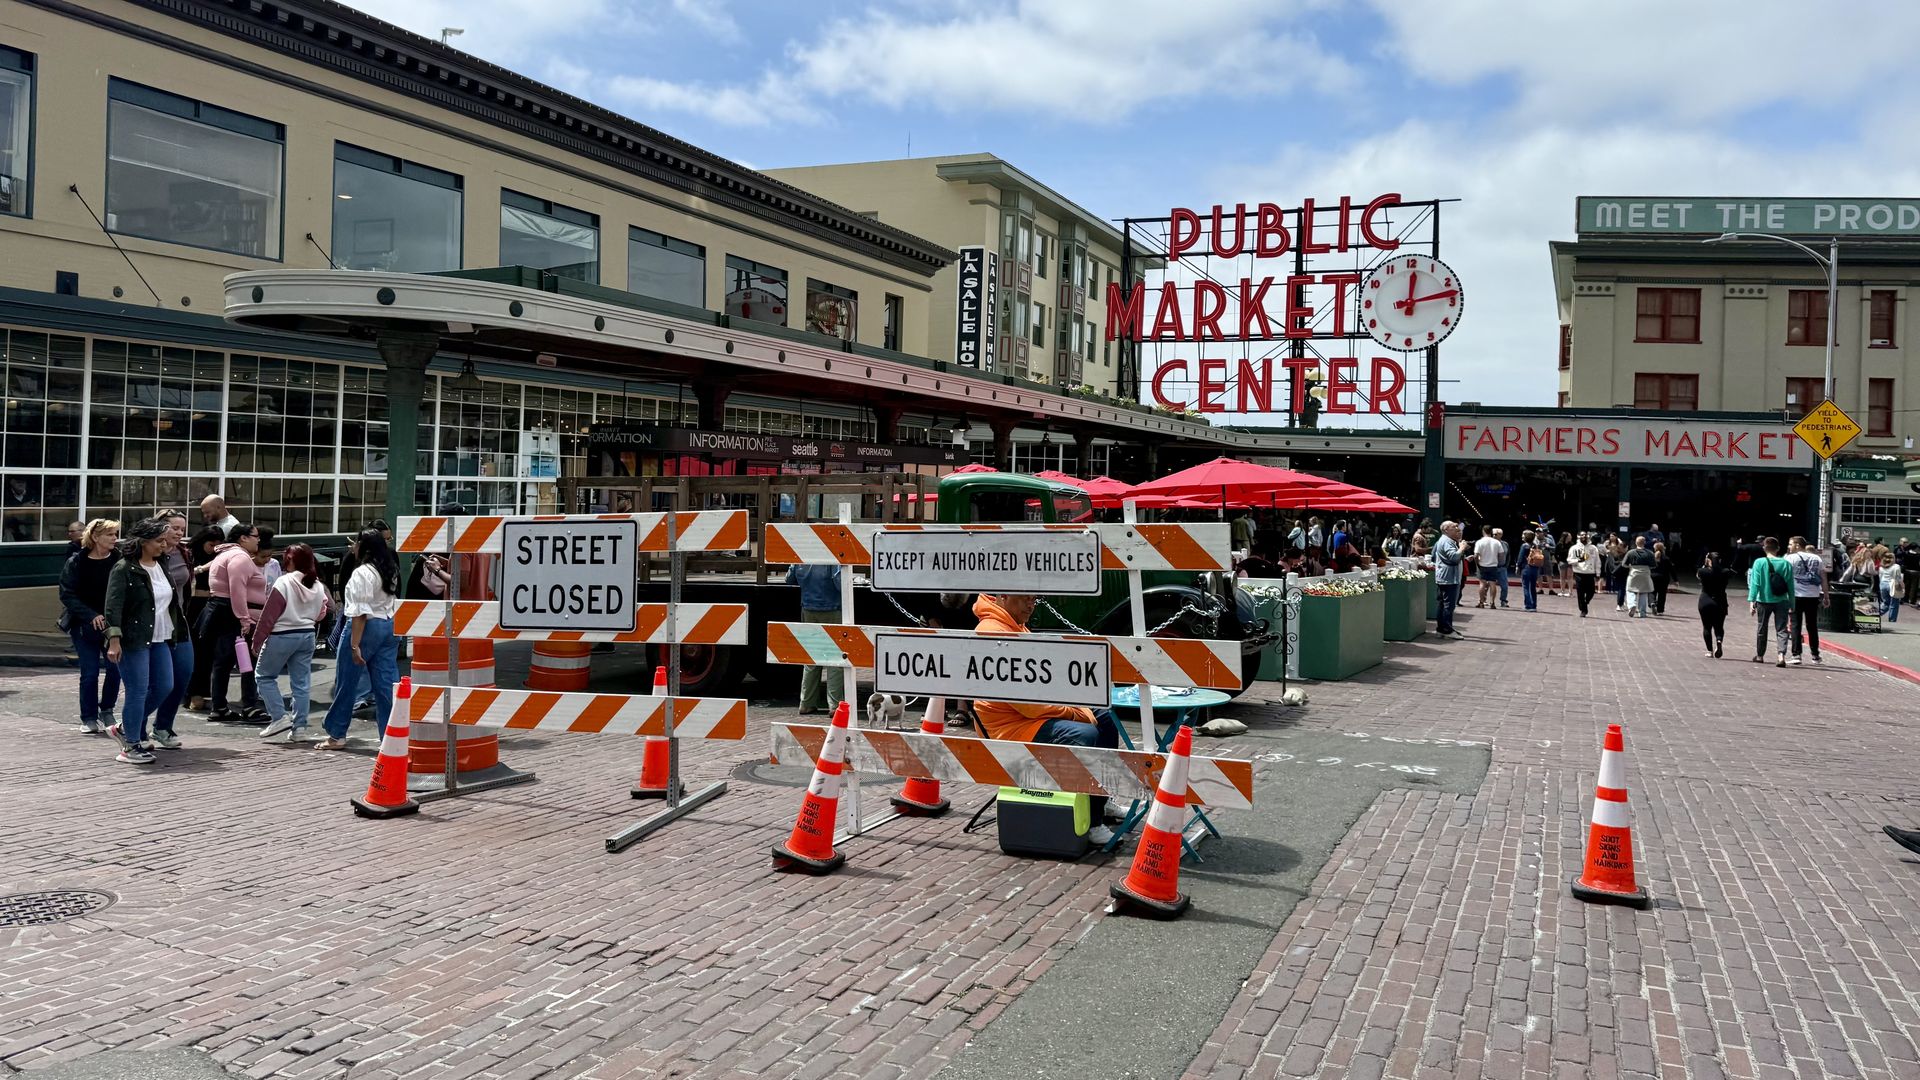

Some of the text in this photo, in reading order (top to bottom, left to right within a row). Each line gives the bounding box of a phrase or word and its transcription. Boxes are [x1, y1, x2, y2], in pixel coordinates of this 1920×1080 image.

[1596, 203, 1920, 231] MEET THE PROD
[1170, 193, 1402, 262] PUBLIC
[963, 252, 978, 272] LA
[990, 255, 996, 277] LA
[1406, 259, 1417, 268] 12
[1386, 265, 1394, 274] 11
[1431, 264, 1434, 272] 1
[1370, 280, 1380, 289] 10
[1444, 278, 1451, 287] 2
[962, 278, 978, 333] SALLE
[1105, 274, 1361, 342] MARKET
[1449, 298, 1456, 307] 3
[1370, 319, 1377, 328] 8
[1441, 317, 1450, 326] 4
[1384, 333, 1391, 342] 7
[1427, 332, 1435, 341] 5
[1404, 338, 1412, 347] 6
[1152, 357, 1406, 415] CENTER
[592, 432, 652, 444] ORMATION
[690, 433, 763, 451] INFORMATION
[1458, 425, 1800, 460] FARMERS MARKET
[792, 442, 819, 456] seattle
[857, 447, 892, 457] INFORMATION
[1836, 470, 1856, 478] Pike
[517, 536, 622, 565] STREET
[878, 552, 1094, 572] EXCEPT AUTHORIZED VEHICLES
[513, 584, 622, 614] CLOSED
[885, 652, 1098, 687] LOCAL ACCESS OK
[1020, 788, 1054, 798] Playmate
[1602, 852, 1618, 860] AND
